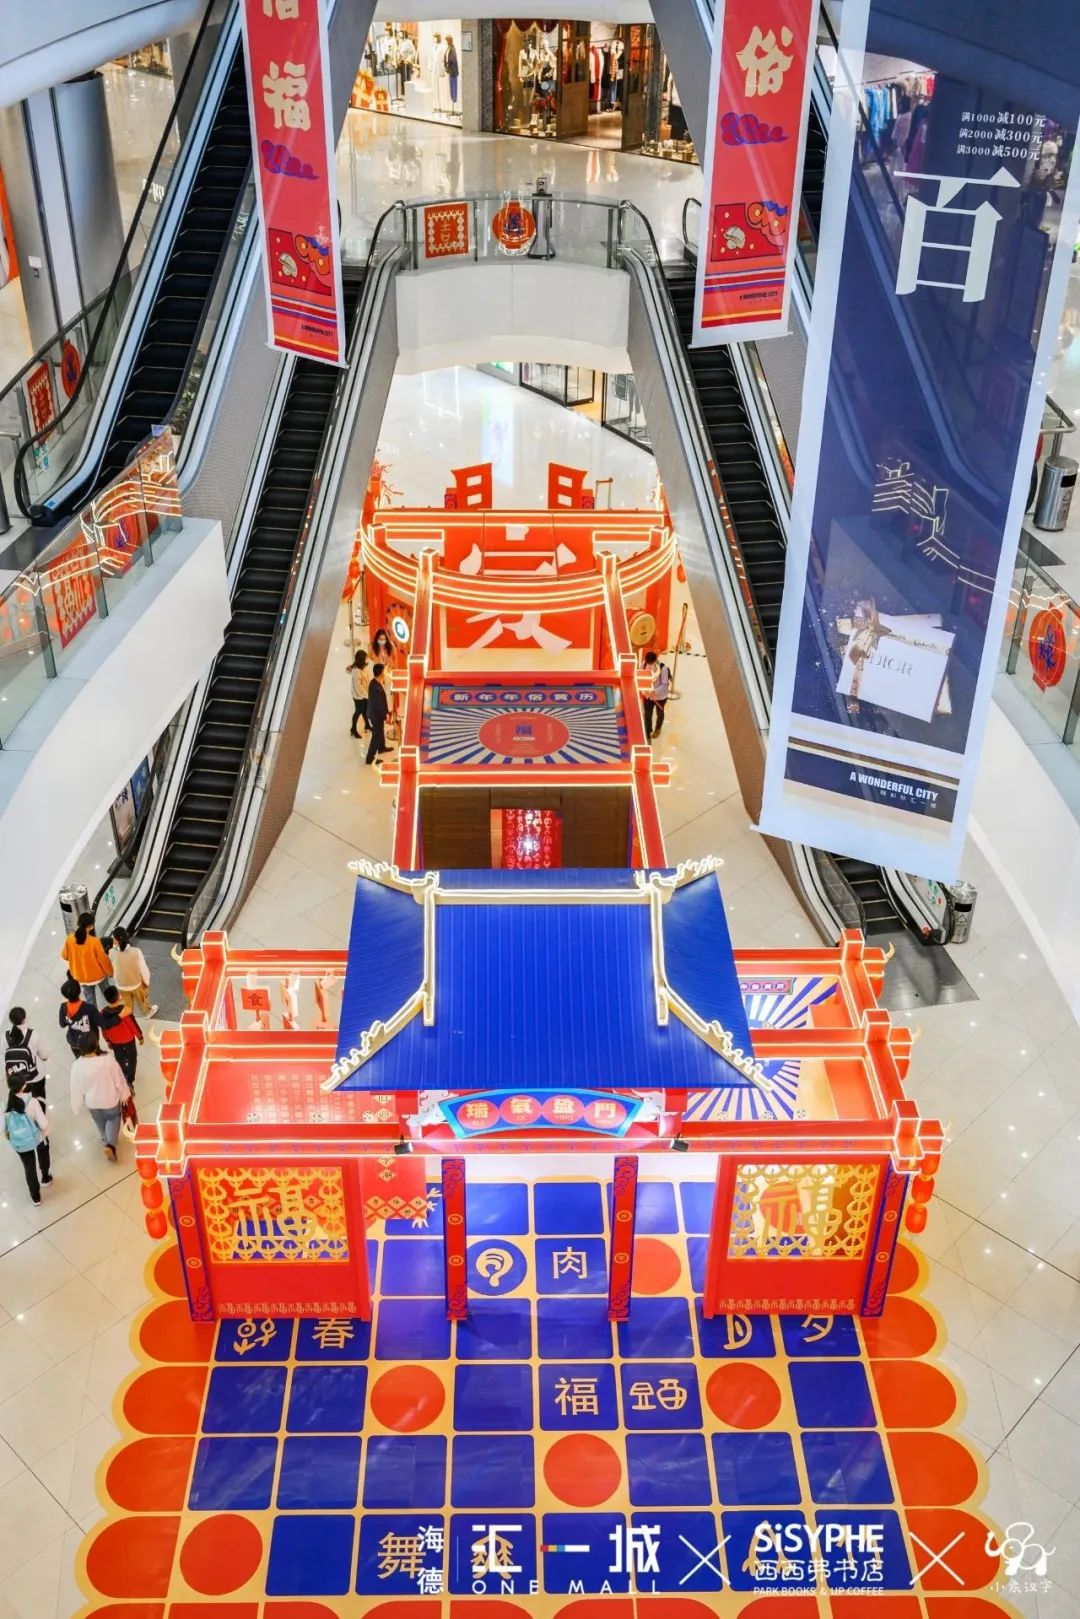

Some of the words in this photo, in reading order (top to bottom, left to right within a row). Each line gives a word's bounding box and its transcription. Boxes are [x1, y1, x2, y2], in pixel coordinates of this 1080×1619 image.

[961, 112, 1046, 128] 满1000减100元
[959, 128, 1042, 144] 满2000减300元
[956, 144, 1040, 160] 满3000减500元
[893, 166, 1021, 302] 百
[869, 652, 913, 677] DIOR
[849, 771, 857, 781] A
[858, 773, 914, 796] WONDERFUL
[915, 787, 939, 802] CITY
[8, 1062, 27, 1075] FILA
[552, 1246, 588, 1280] 肉
[312, 1317, 354, 1349] 春
[555, 1377, 599, 1416] 福
[377, 1531, 426, 1580] 舞
